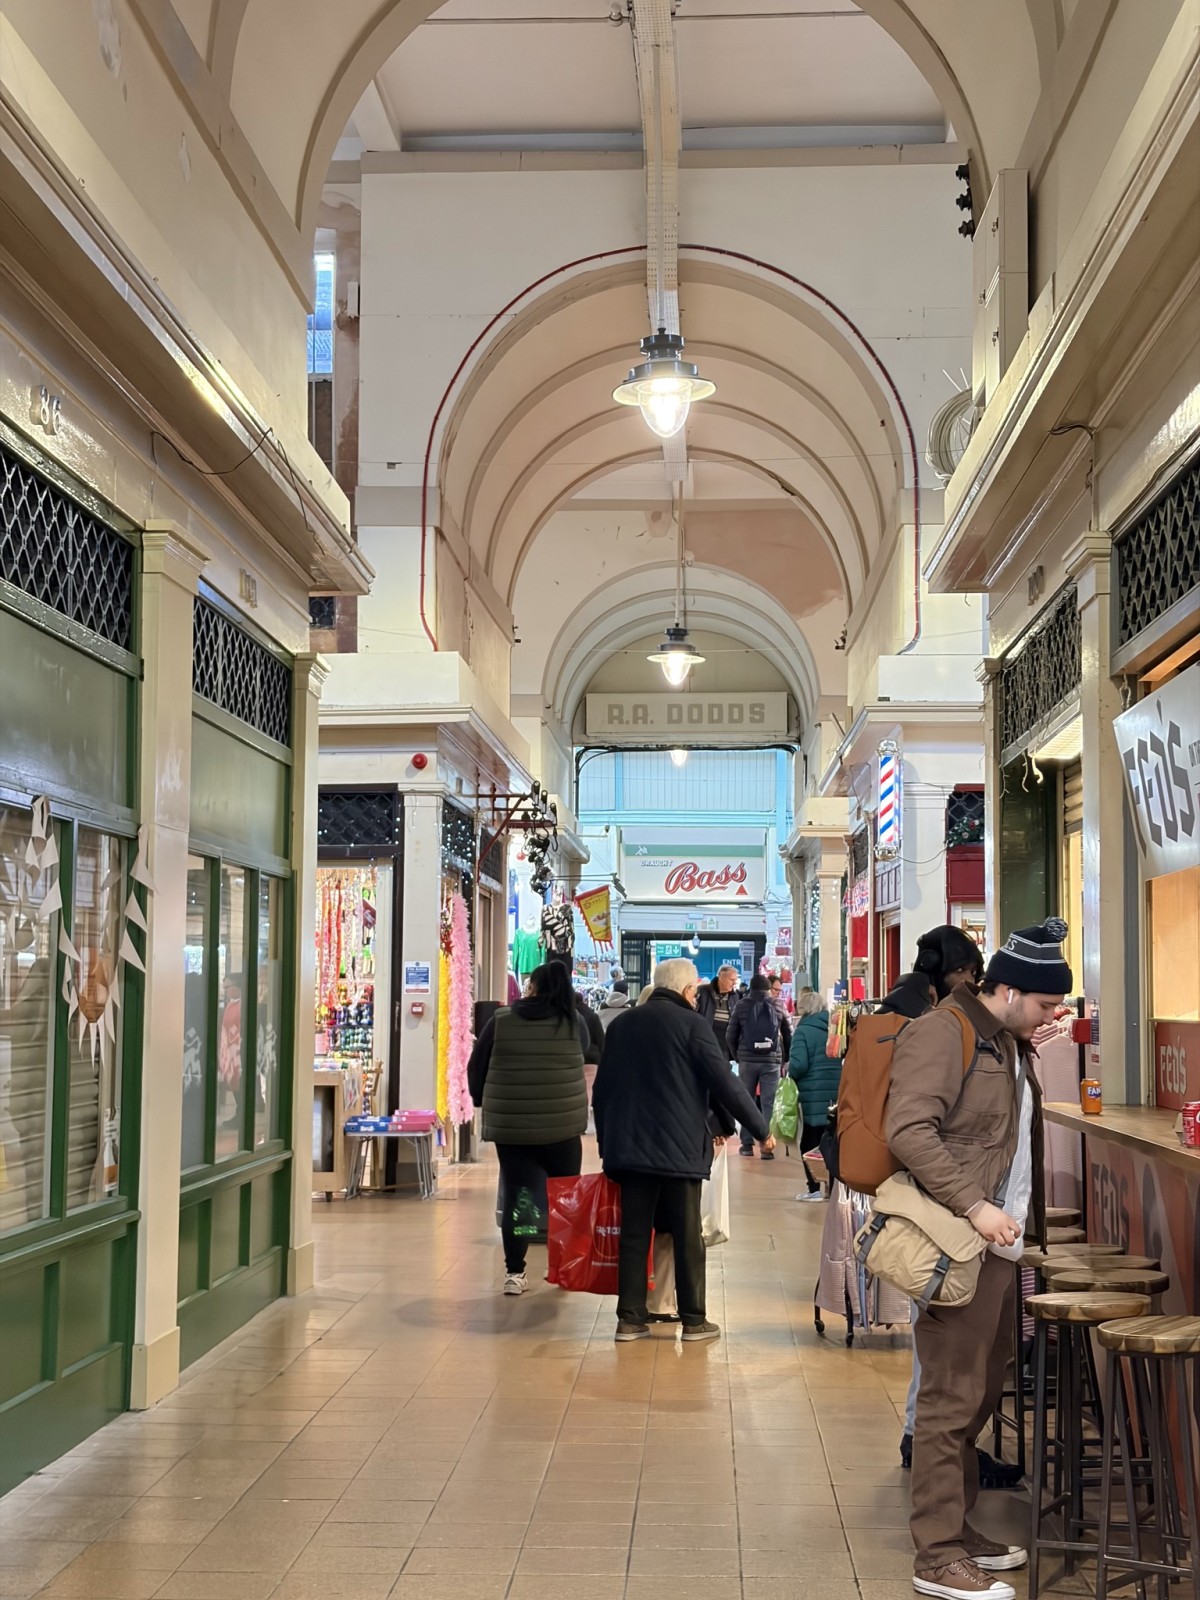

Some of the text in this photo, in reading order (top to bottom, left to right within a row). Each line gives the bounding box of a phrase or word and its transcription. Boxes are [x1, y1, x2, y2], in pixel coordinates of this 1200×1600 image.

[607, 702, 765, 725] R.A. DODDS
[664, 861, 748, 895] Bass
[722, 958, 742, 966] ENTR
[1087, 1085, 1101, 1095] FAN
